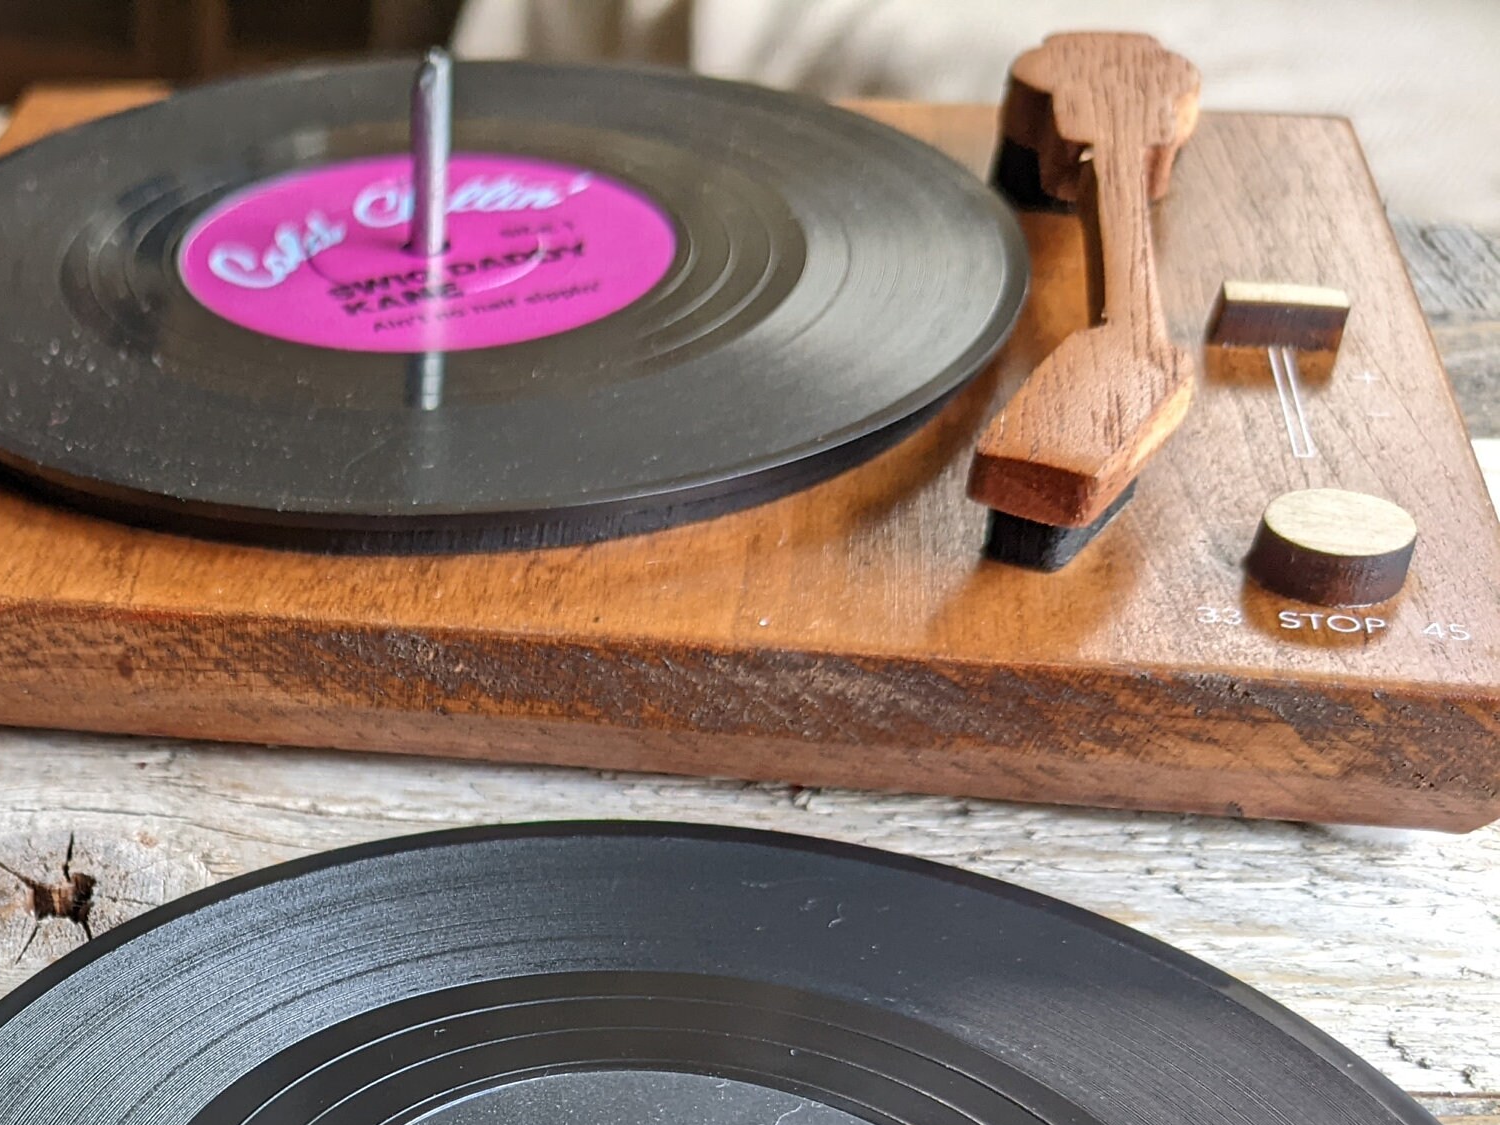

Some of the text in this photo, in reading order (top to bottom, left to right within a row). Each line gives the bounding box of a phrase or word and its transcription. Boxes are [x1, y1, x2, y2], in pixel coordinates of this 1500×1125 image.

[208, 210, 348, 290] Cold
[342, 282, 465, 315] KANE
[1196, 606, 1471, 641] 33 STOP 45
